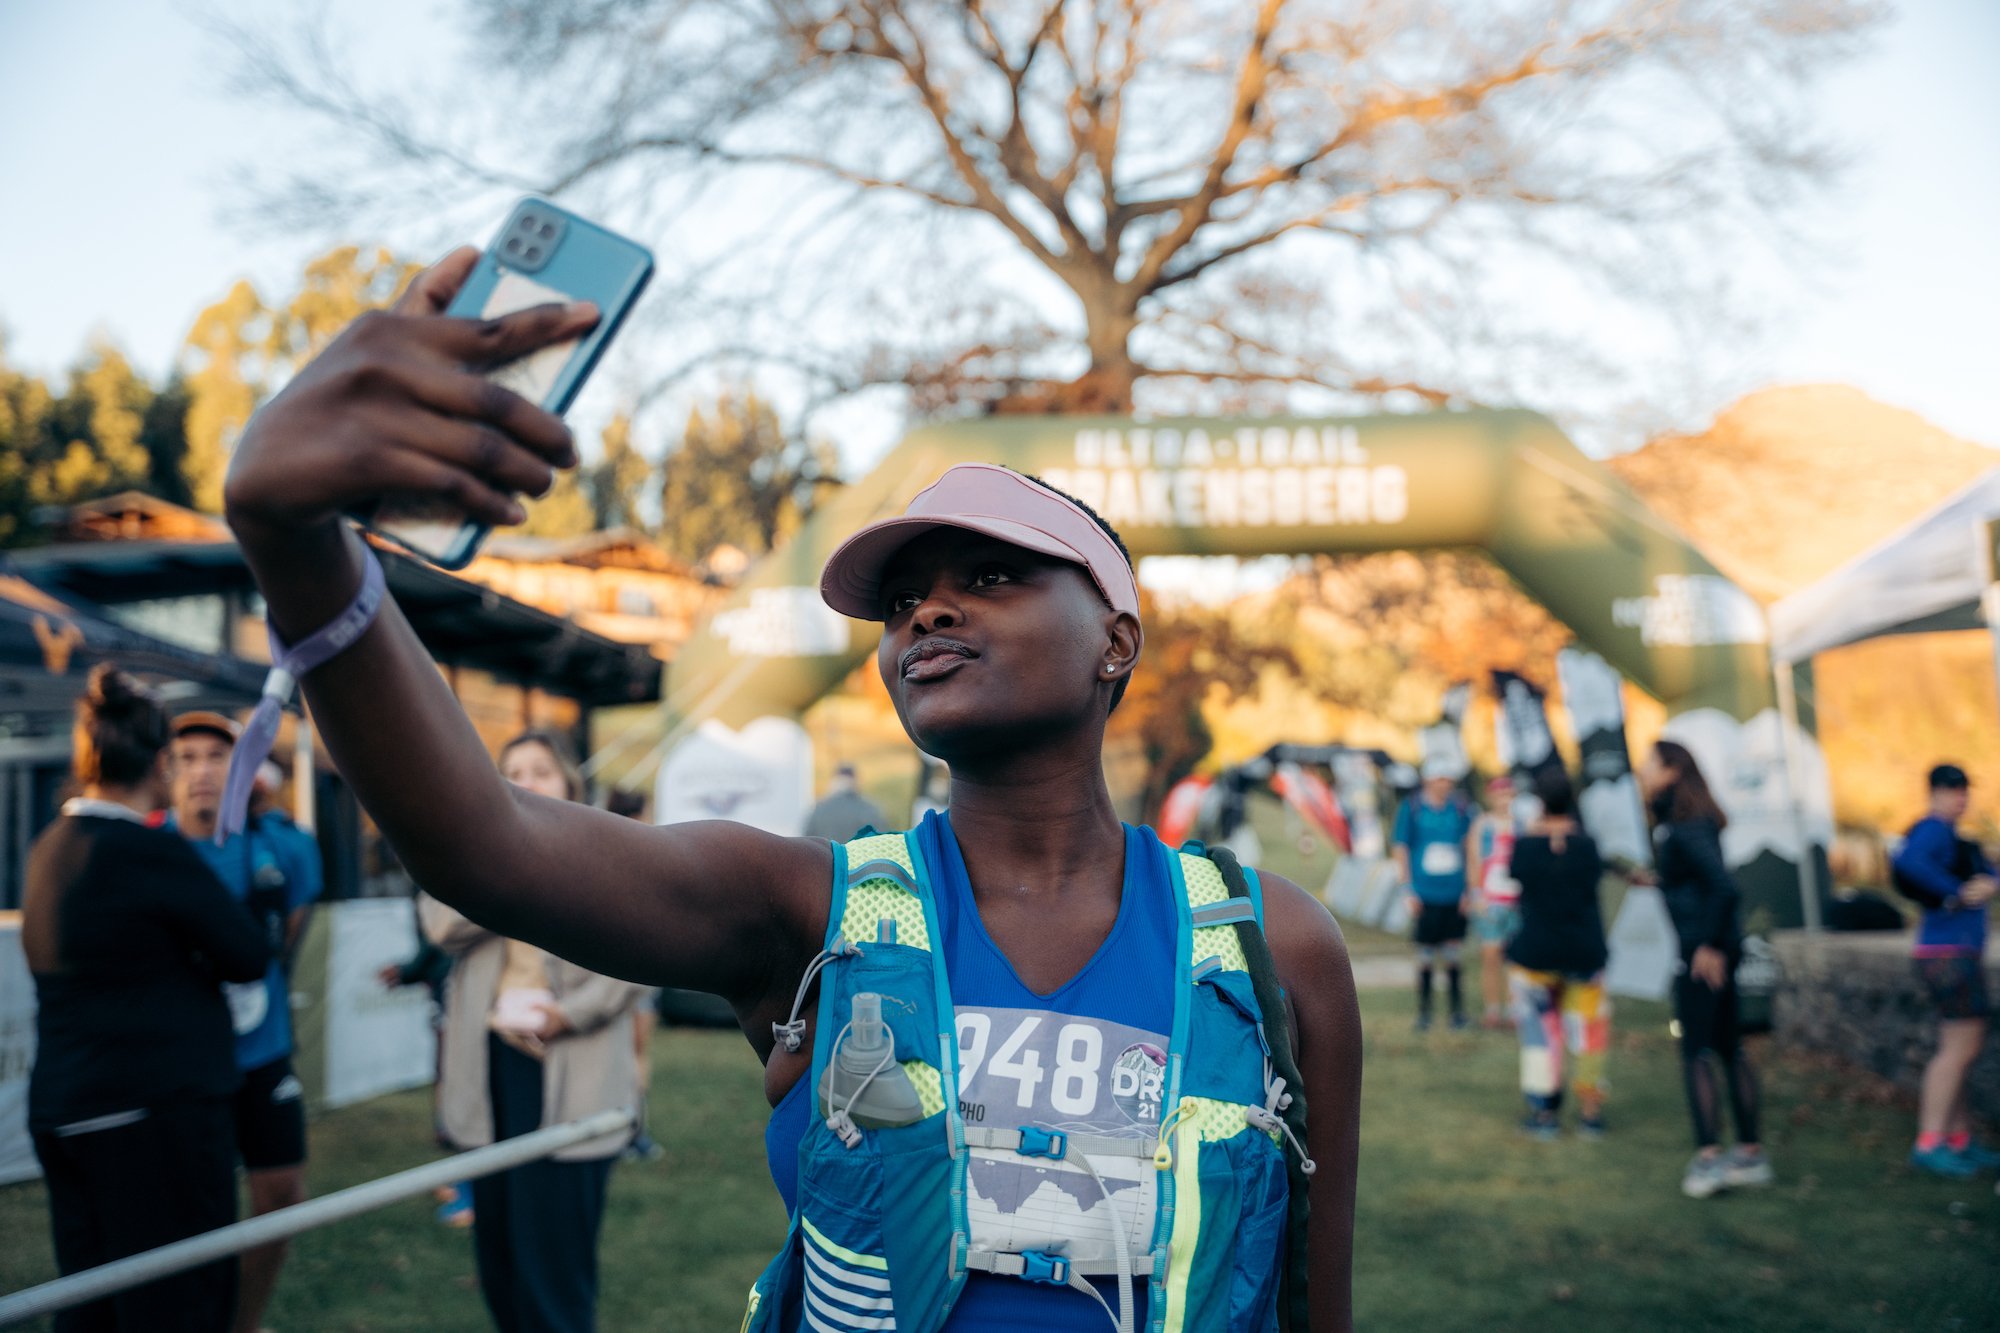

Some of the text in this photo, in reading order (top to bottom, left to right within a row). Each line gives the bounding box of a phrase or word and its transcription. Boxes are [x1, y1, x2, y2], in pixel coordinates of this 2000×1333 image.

[955, 1012, 1103, 1116] 948
[1112, 1066, 1165, 1103] DR
[1137, 1102, 1156, 1120] 21
